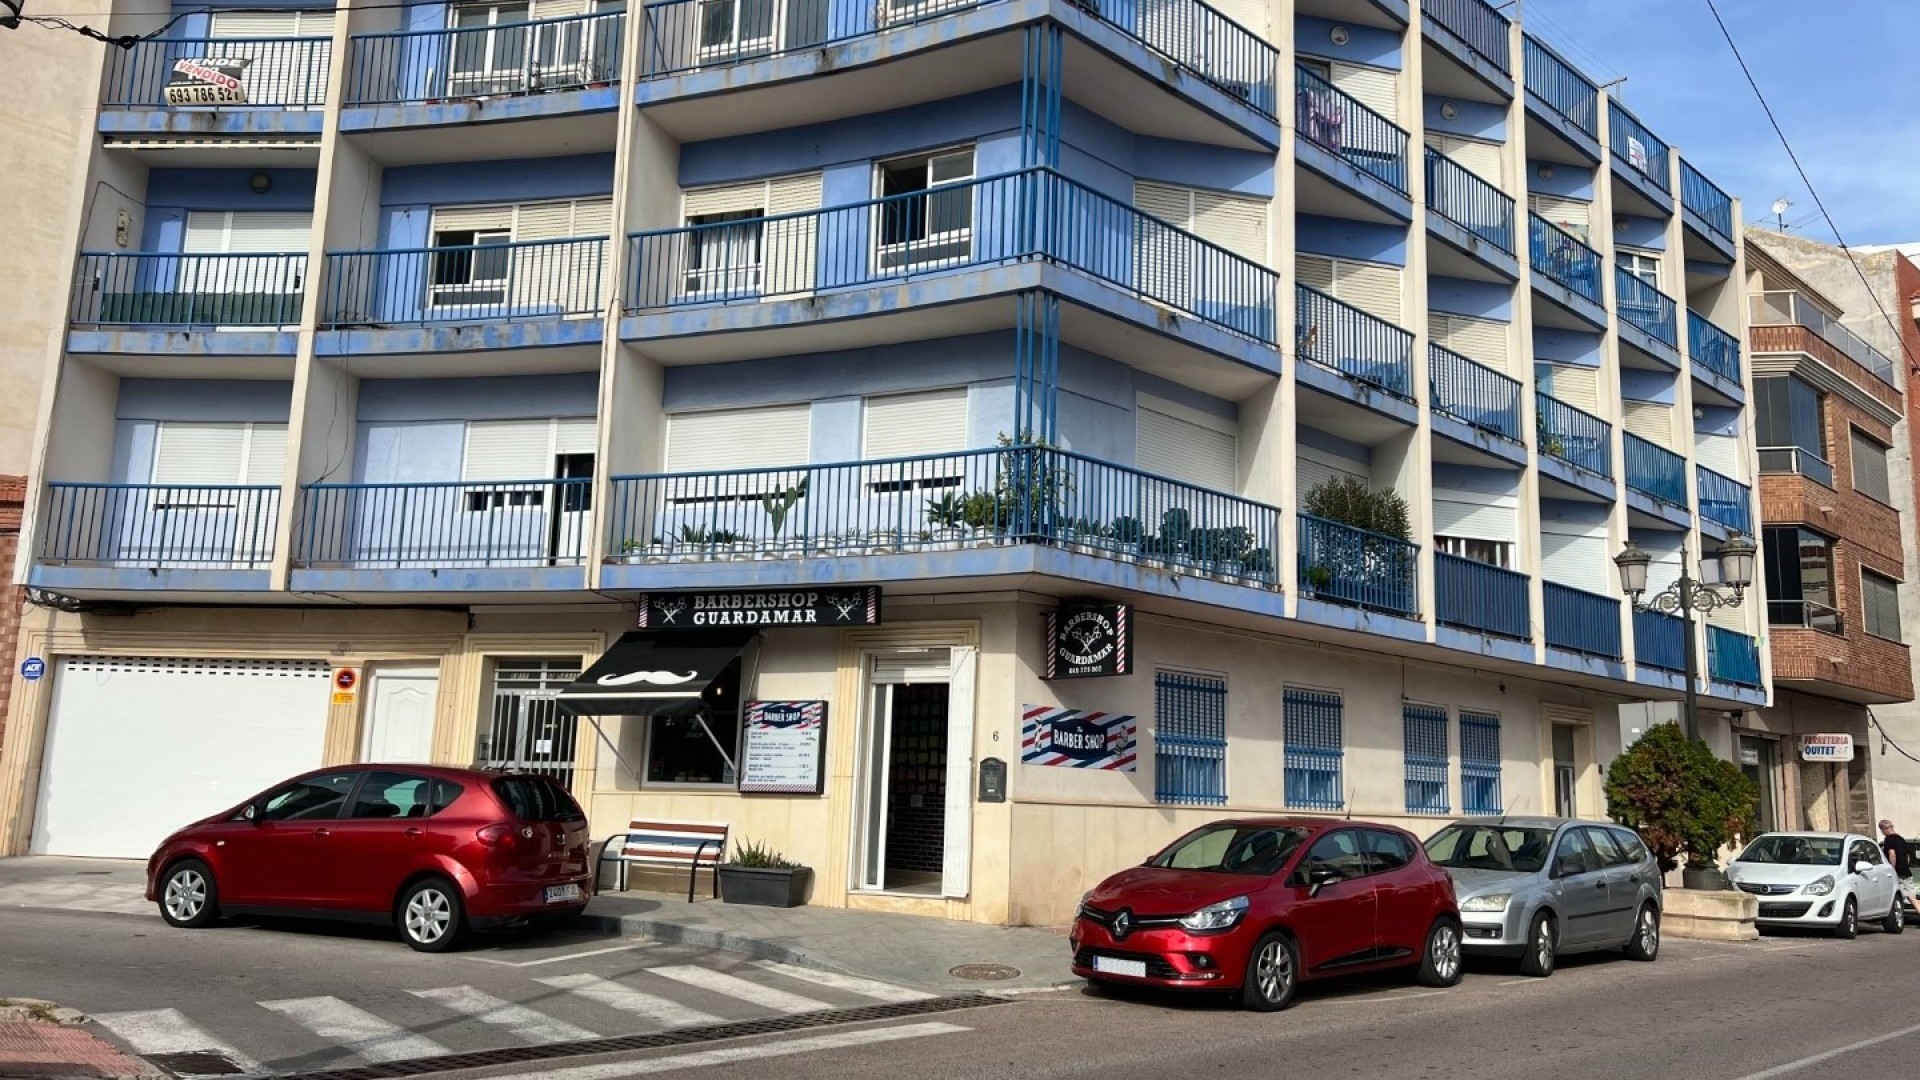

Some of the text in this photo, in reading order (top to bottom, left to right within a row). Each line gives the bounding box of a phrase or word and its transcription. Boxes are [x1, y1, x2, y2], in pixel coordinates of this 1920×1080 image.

[180, 63, 238, 89] VENDIDO
[170, 88, 191, 102] 693
[193, 87, 215, 101] 786
[693, 592, 819, 610] BARBERSHOP
[692, 609, 817, 625] GUARDAMAR
[1060, 611, 1114, 641] BARBERSHOP
[1060, 643, 1114, 665] GUARDAMAR
[992, 730, 1000, 742] 6
[1053, 728, 1105, 750] BARBER SHOP
[1805, 746, 1835, 755] QUITET
